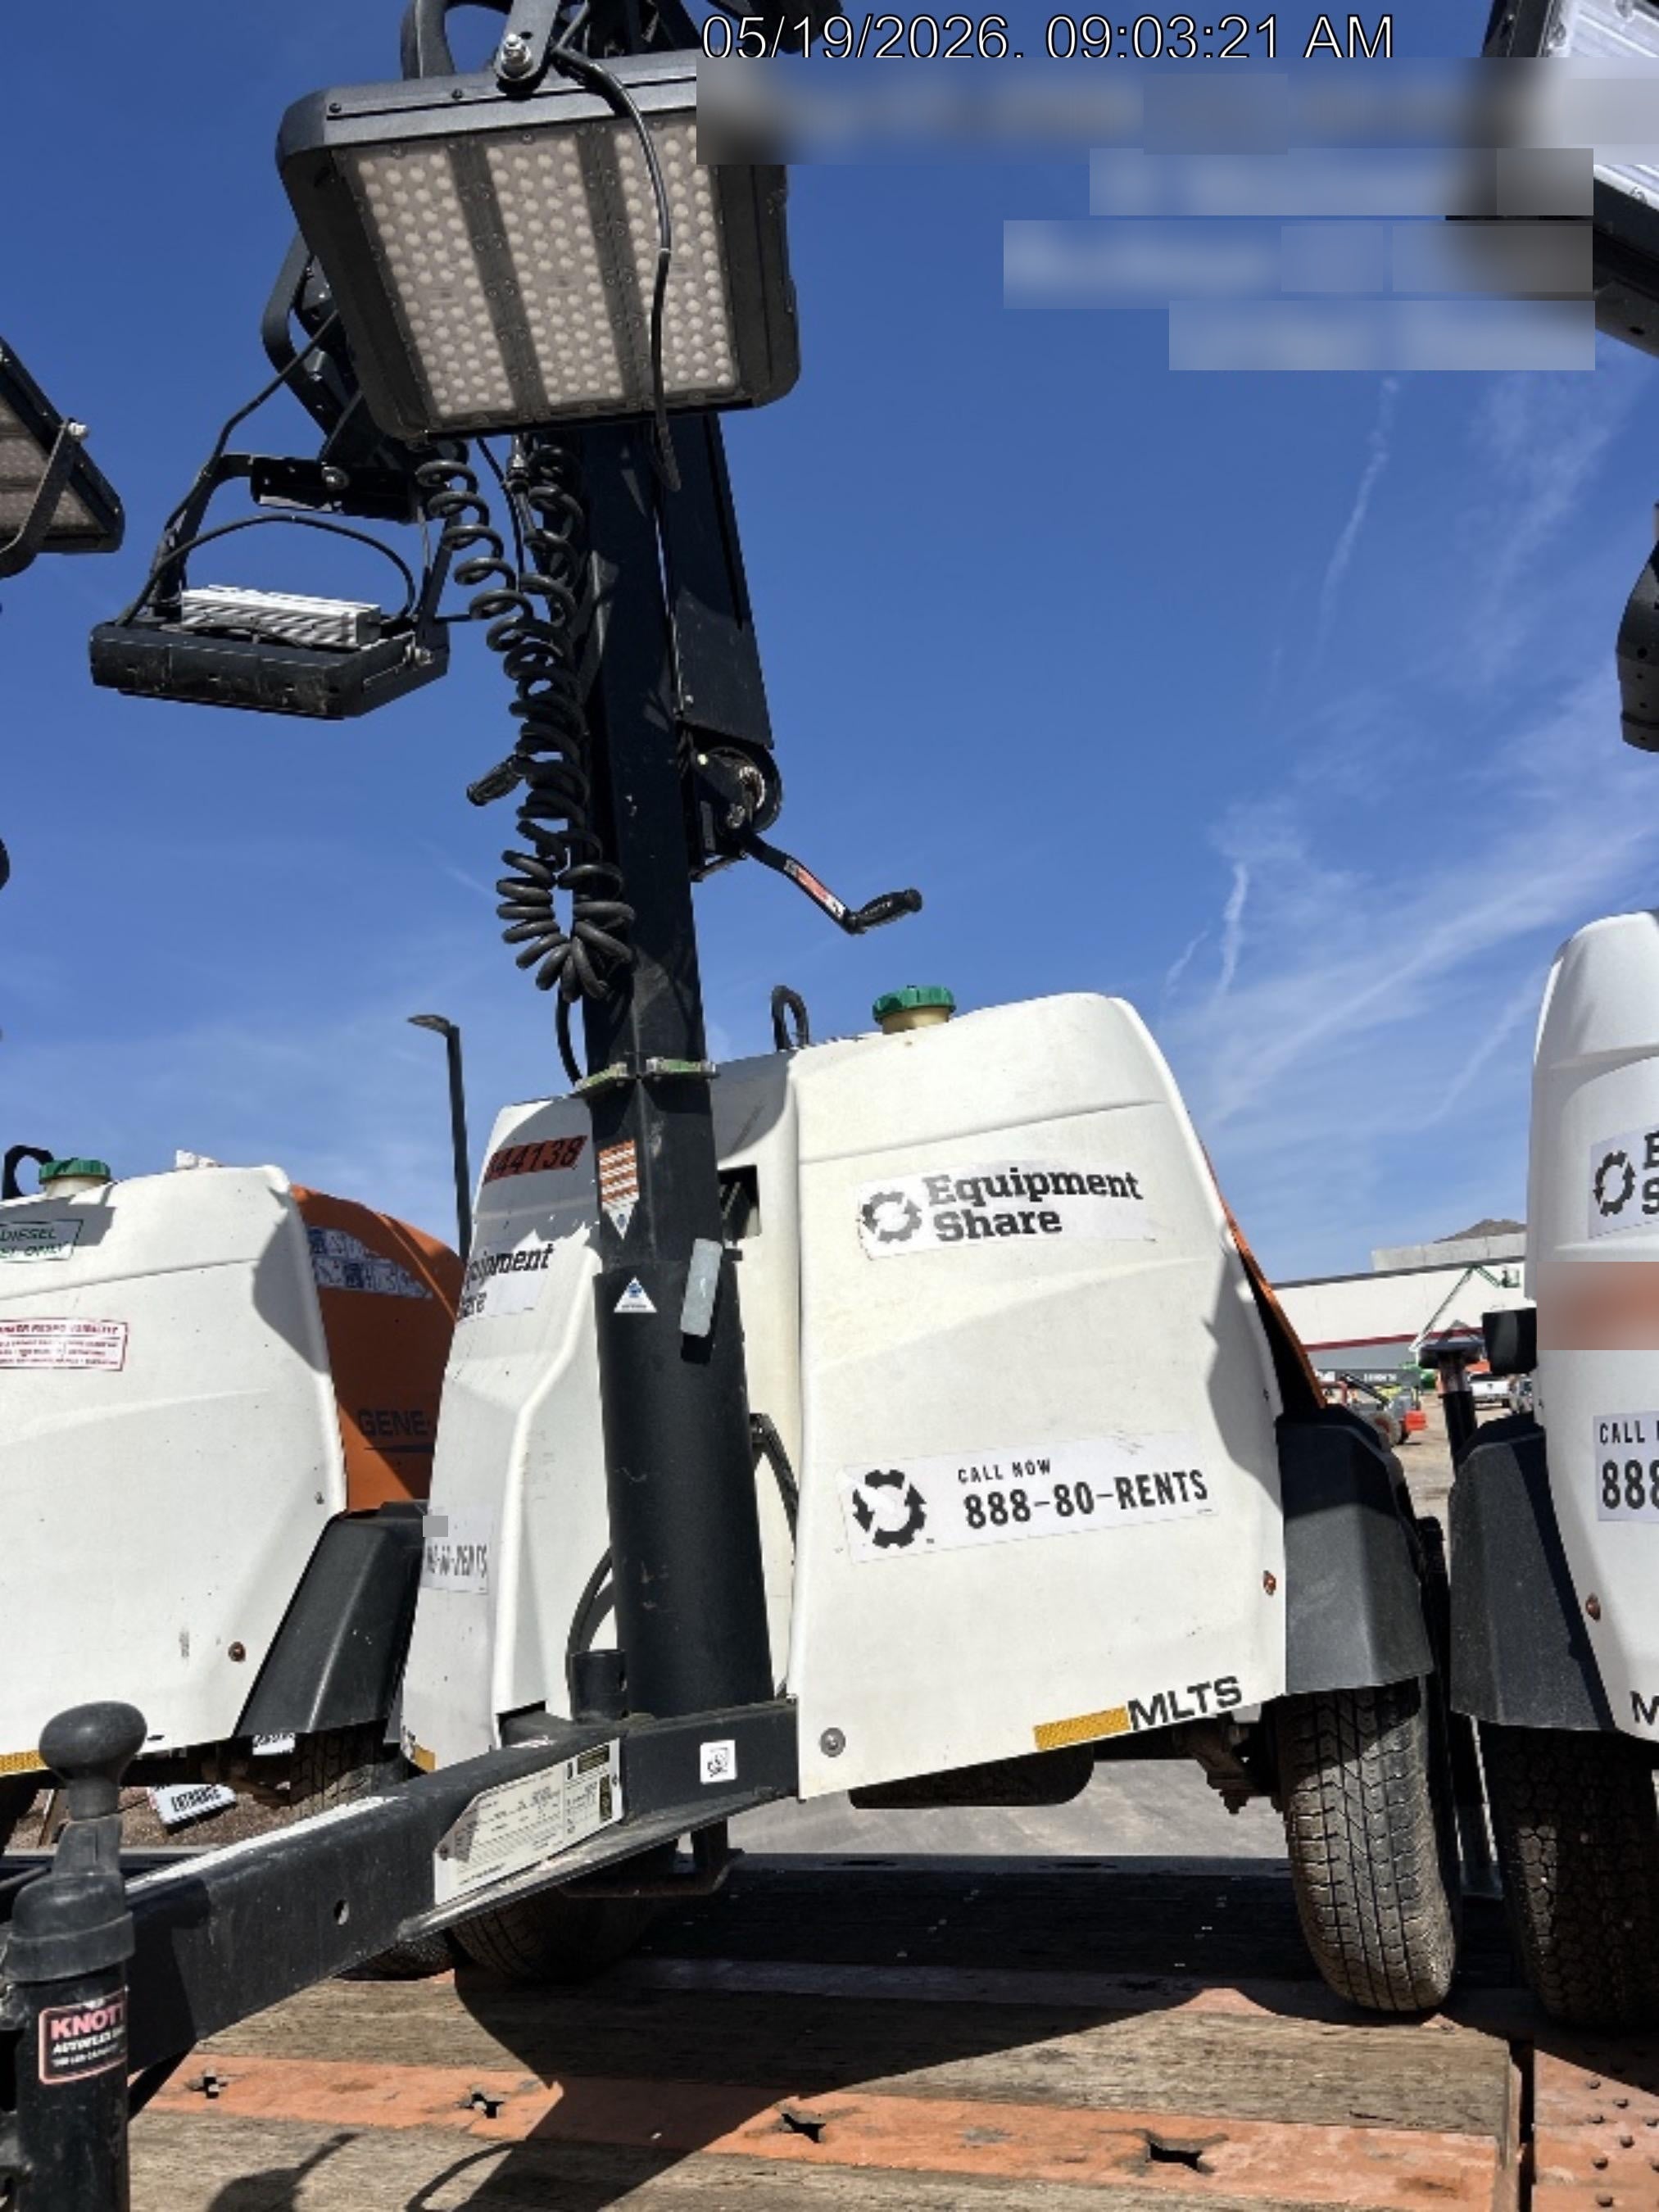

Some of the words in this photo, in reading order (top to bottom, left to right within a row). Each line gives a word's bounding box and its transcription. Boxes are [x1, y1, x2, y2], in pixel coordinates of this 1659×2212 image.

[922, 1167, 1144, 1207] Equipment
[932, 1208, 1063, 1243] Share
[1599, 1419, 1646, 1444] CALL
[958, 1465, 1004, 1484] CALL
[1012, 1457, 1051, 1478] NOW
[963, 1470, 1208, 1530] 888-80-RENTS
[1127, 1675, 1242, 1731] MLTS
